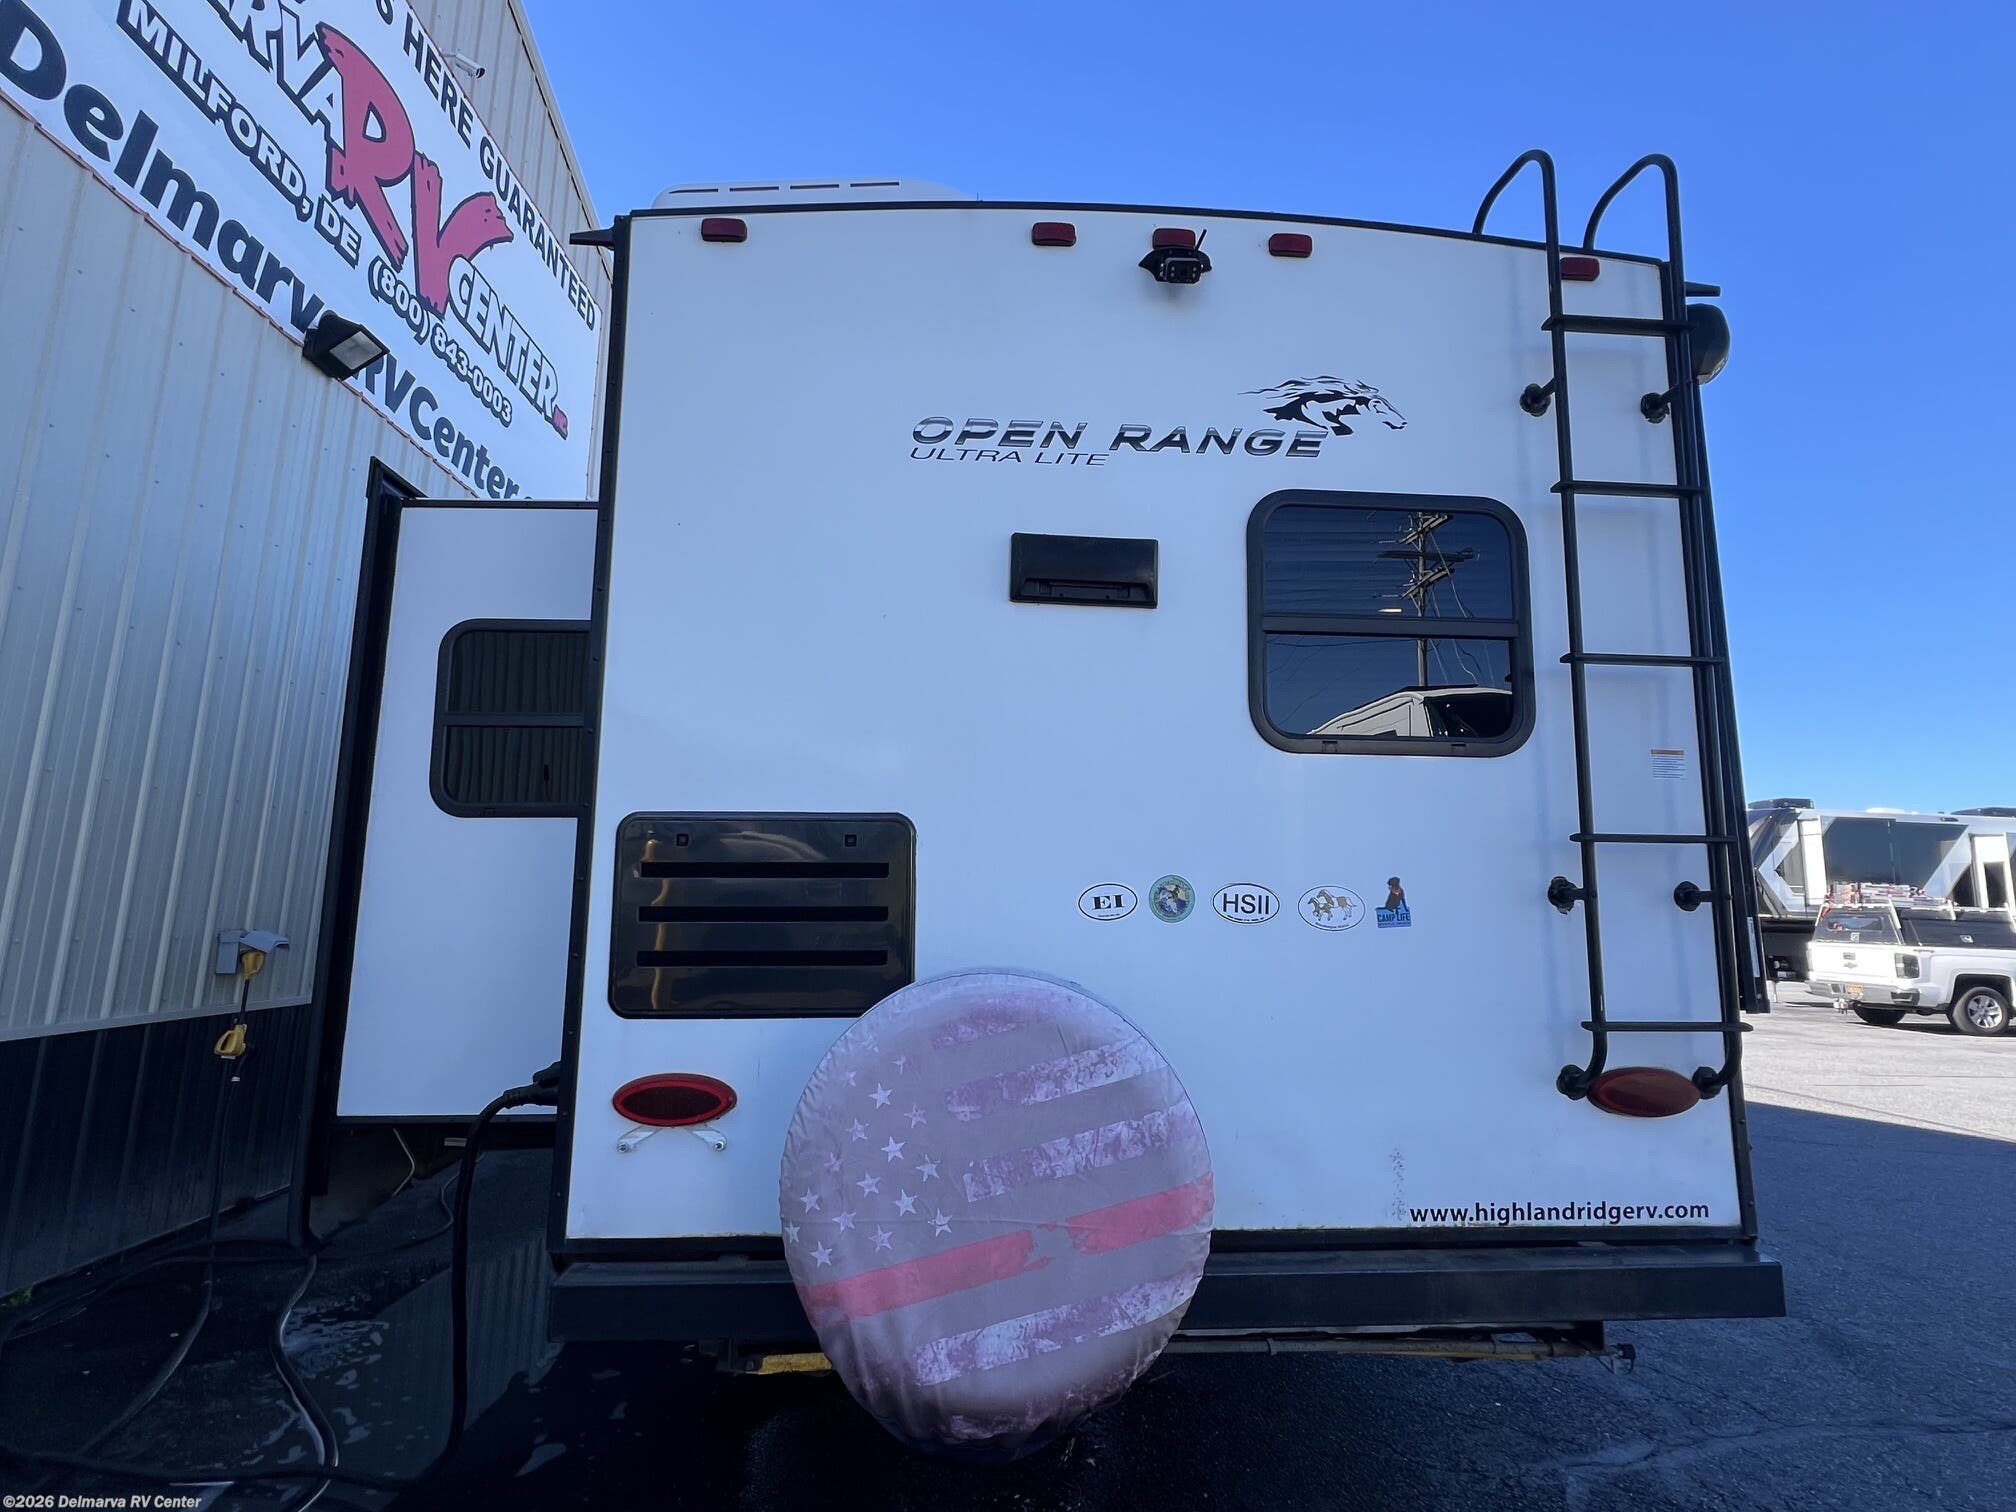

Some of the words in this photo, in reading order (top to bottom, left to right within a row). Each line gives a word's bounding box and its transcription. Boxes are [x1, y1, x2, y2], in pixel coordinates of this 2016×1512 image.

[316, 21, 514, 320] RV
[404, 13, 474, 149] HERE
[479, 137, 596, 331] GUARANTEED
[117, 0, 314, 222] MILFORD,
[314, 194, 363, 268] DE
[368, 256, 432, 345] (800)
[431, 322, 513, 428] 843-0003
[447, 255, 559, 425] CENTER
[910, 447, 1023, 464] ULTRA
[1035, 450, 1110, 467] LITE
[912, 416, 1088, 450] OPEN
[1109, 423, 1329, 458] RANGE
[1092, 894, 1124, 910] EI
[1222, 893, 1270, 915] HSII
[1410, 1201, 1709, 1226] www.highlandridgerv.com
